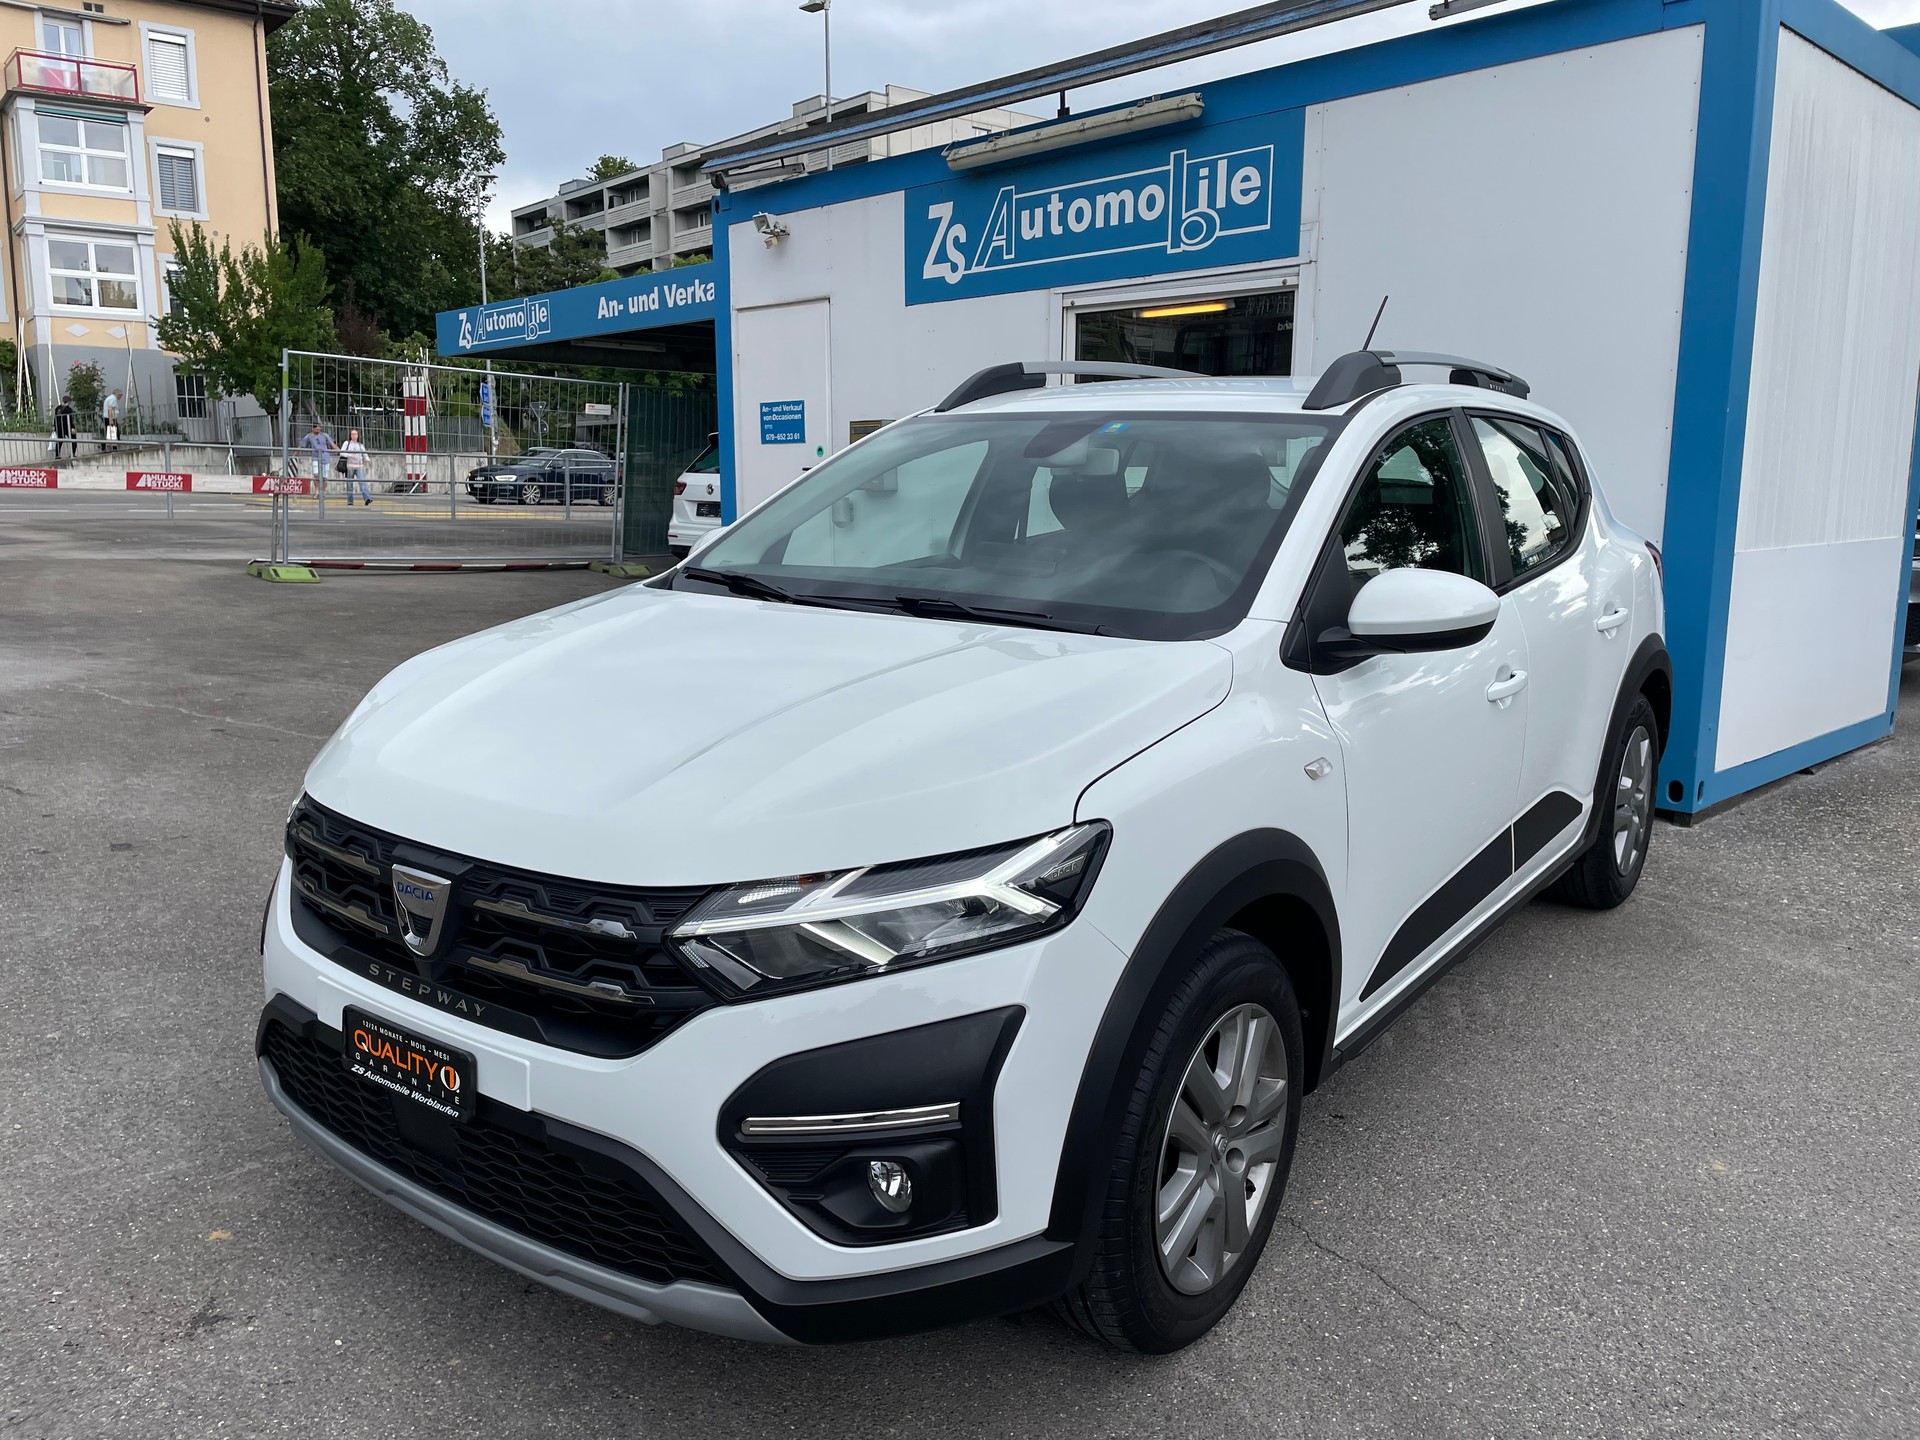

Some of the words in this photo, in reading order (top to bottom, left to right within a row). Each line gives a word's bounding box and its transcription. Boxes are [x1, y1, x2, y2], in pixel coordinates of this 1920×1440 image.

[971, 149, 1262, 271] Automobile
[473, 298, 548, 343] Automobile
[597, 296, 624, 319] An-
[628, 286, 659, 314] und
[663, 279, 715, 309] Verka
[396, 881, 435, 903] DACIA
[368, 963, 486, 1017] STEPWAY
[362, 1020, 378, 1031] 12/24
[379, 1027, 403, 1043] MONATE
[410, 1040, 427, 1052] MOIS
[434, 1049, 450, 1061] MESI
[350, 1063, 366, 1076] ZS
[364, 1070, 410, 1096] Automobile
[411, 1090, 460, 1118] Worblaufen
